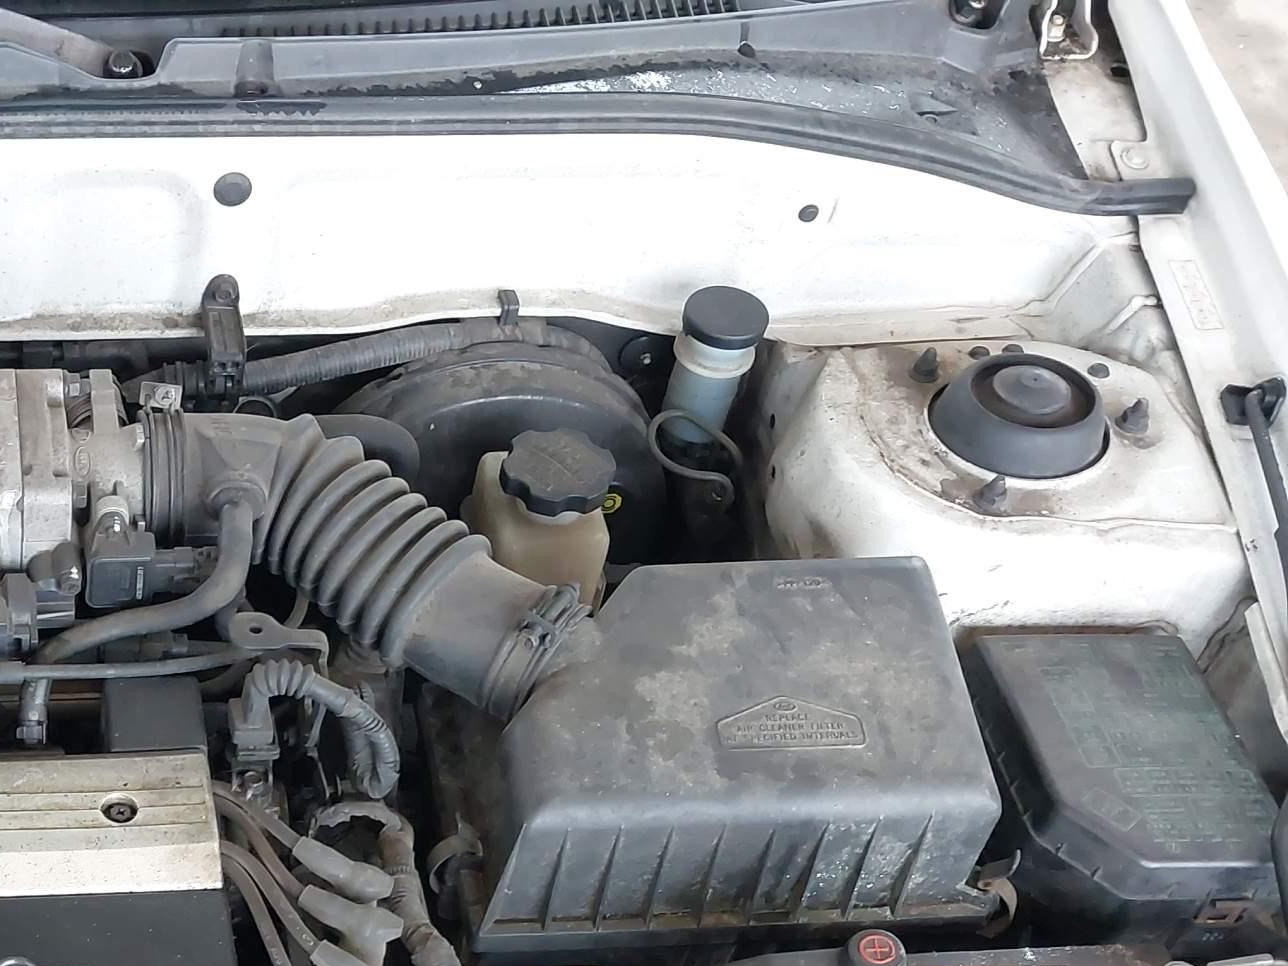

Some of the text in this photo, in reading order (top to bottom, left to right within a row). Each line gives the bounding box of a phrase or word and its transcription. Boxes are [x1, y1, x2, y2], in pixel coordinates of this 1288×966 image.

[764, 713, 808, 722] REPLACE
[759, 723, 805, 732] CLEANER
[811, 722, 844, 731] FILTER
